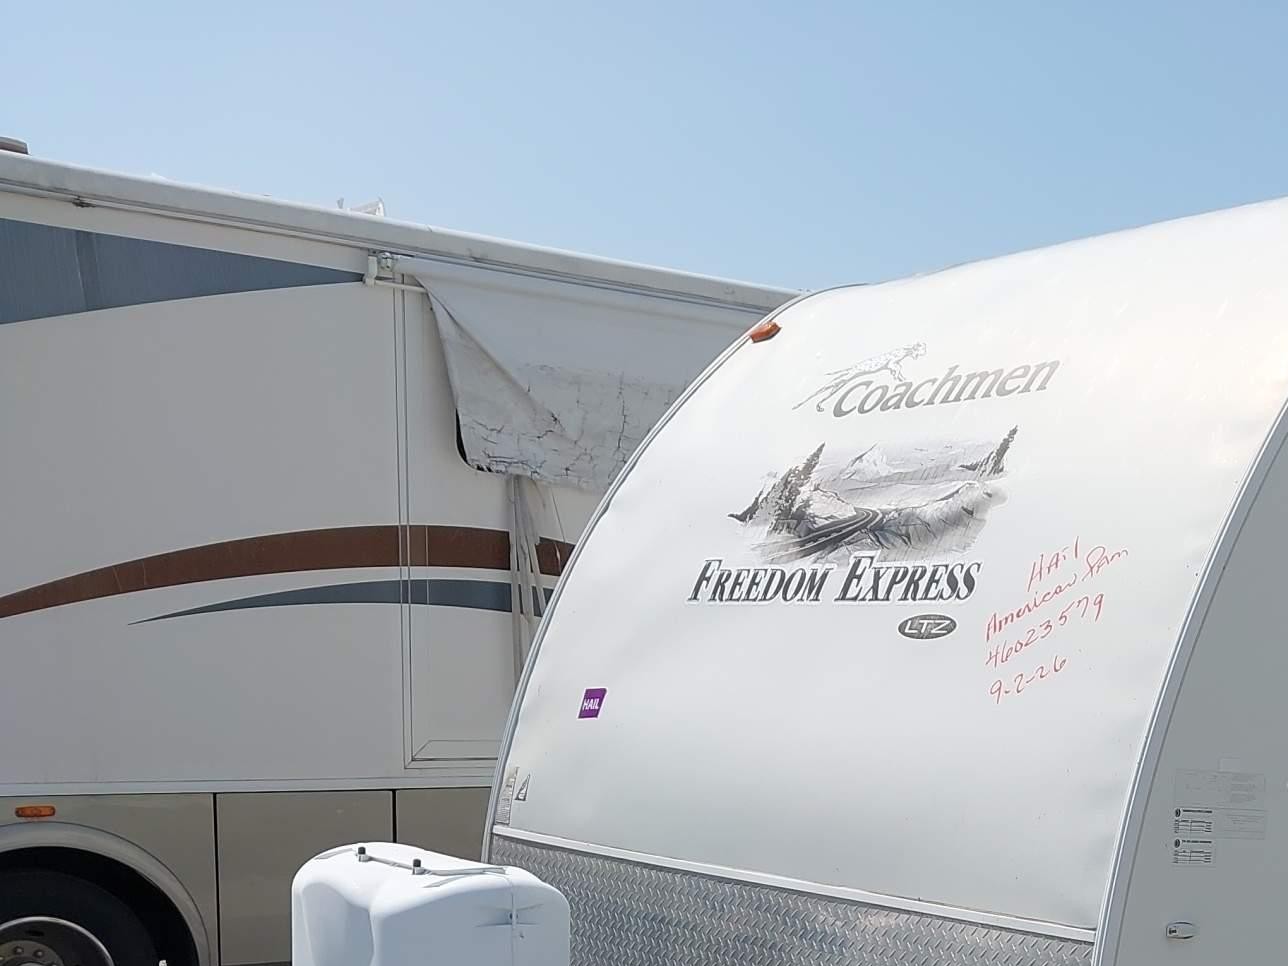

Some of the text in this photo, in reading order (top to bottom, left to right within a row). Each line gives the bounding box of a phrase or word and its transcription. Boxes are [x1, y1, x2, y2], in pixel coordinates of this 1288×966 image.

[832, 360, 1061, 418] Coachmen
[688, 555, 981, 602] FREEDOM EXPRESS
[904, 621, 952, 635] LTZ
[985, 593, 1105, 668] 46023579
[581, 698, 600, 711] HAIL
